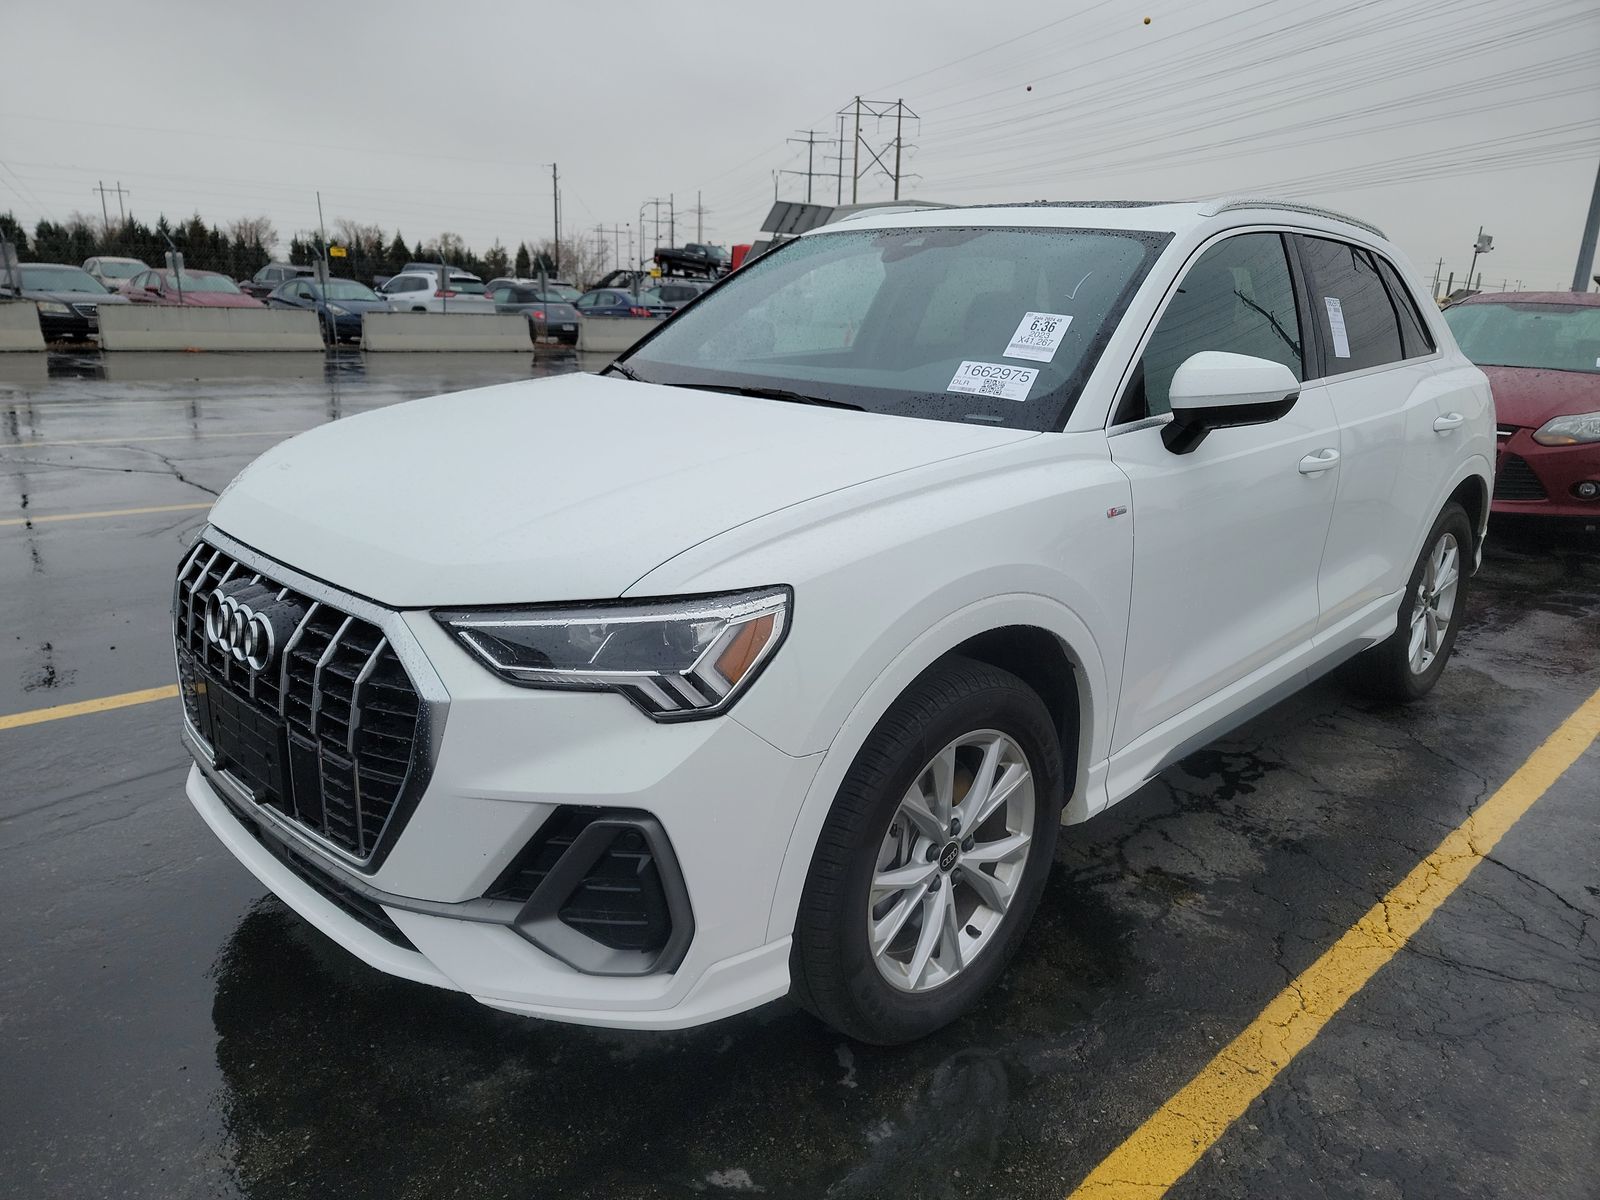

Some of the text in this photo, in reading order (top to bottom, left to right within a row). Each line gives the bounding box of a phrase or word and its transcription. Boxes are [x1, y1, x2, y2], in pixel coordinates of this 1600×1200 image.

[1030, 320, 1057, 333] 6:36
[1028, 331, 1051, 339] 2023
[964, 364, 1032, 383] 1662975
